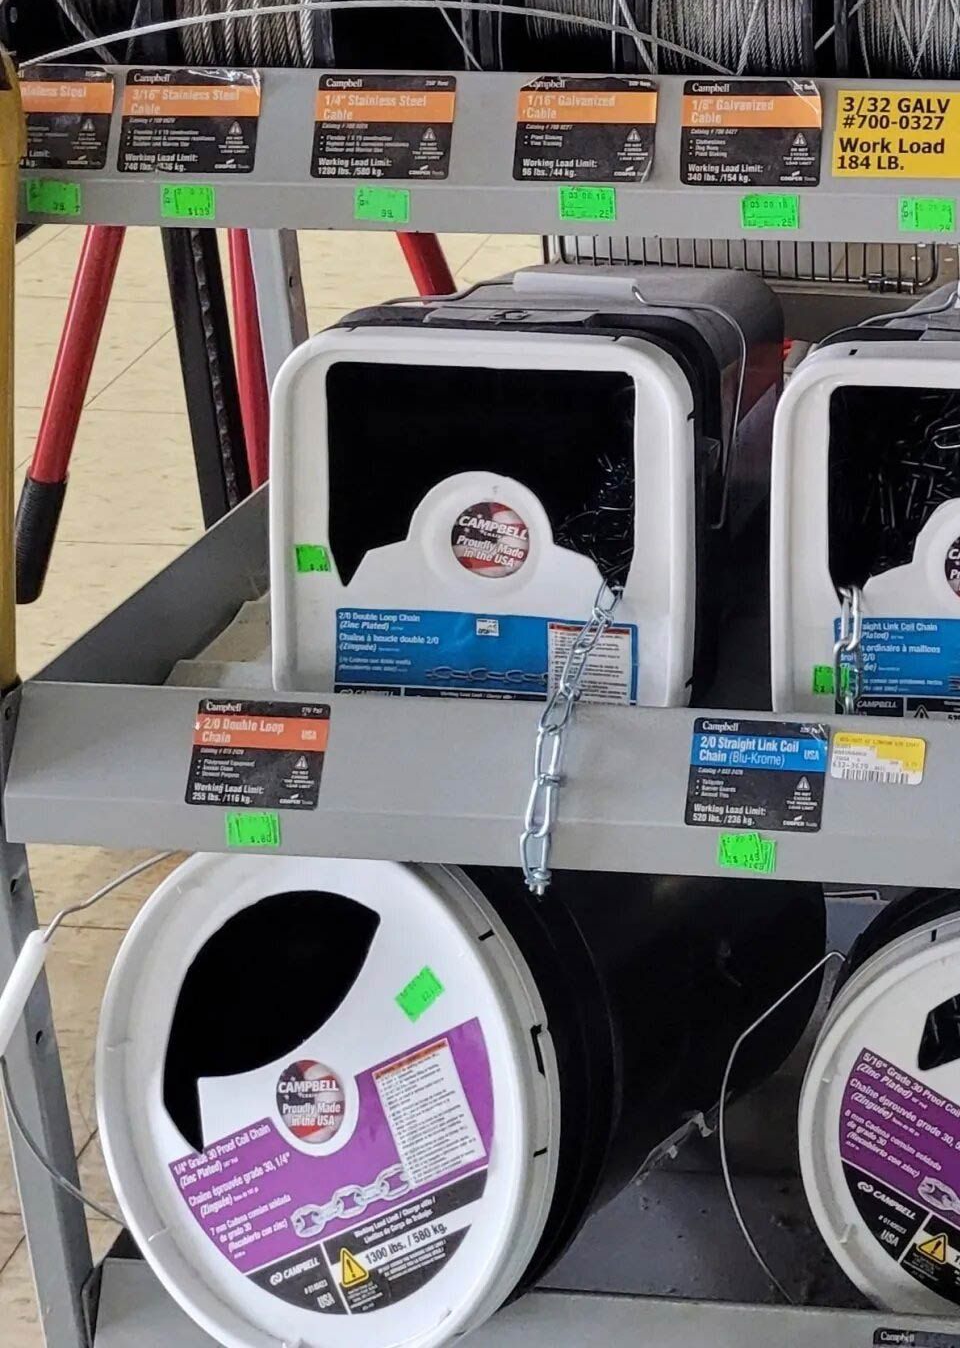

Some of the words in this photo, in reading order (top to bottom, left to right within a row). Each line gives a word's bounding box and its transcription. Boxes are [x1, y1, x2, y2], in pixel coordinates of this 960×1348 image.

[326, 79, 362, 89] Campbell
[349, 96, 396, 106] Stainless
[399, 96, 426, 106] Steel
[842, 96, 890, 114] 3/32
[897, 98, 950, 114] GALV
[324, 109, 352, 119] Cable
[842, 115, 944, 130] #700-0327
[840, 137, 891, 154] Work
[899, 139, 945, 154] Load
[838, 155, 871, 170] 184
[877, 158, 904, 170] LB.
[459, 516, 528, 540] CAMPBELL
[457, 535, 497, 554] Proudly
[498, 544, 524, 558] Made
[476, 550, 492, 561] the
[494, 553, 515, 567] USA
[206, 703, 242, 714] Campbell
[203, 719, 220, 729] 2/0
[223, 719, 257, 731] Double
[260, 721, 284, 734] Loop
[703, 721, 738, 732] Campbell
[202, 731, 231, 742] Chain
[301, 730, 317, 740] USA
[701, 736, 716, 749] 2/0
[718, 737, 755, 752] Straight
[758, 740, 778, 752] Link
[781, 741, 799, 752] Coil
[699, 750, 726, 762] Chain
[729, 751, 785, 768] (Blu-Krome)
[804, 750, 819, 760] USA
[279, 1080, 339, 1093] CAMPBELL
[282, 1103, 316, 1115] Proudly
[318, 1102, 340, 1114] Made
[302, 1116, 315, 1126] the
[317, 1115, 334, 1126] USA
